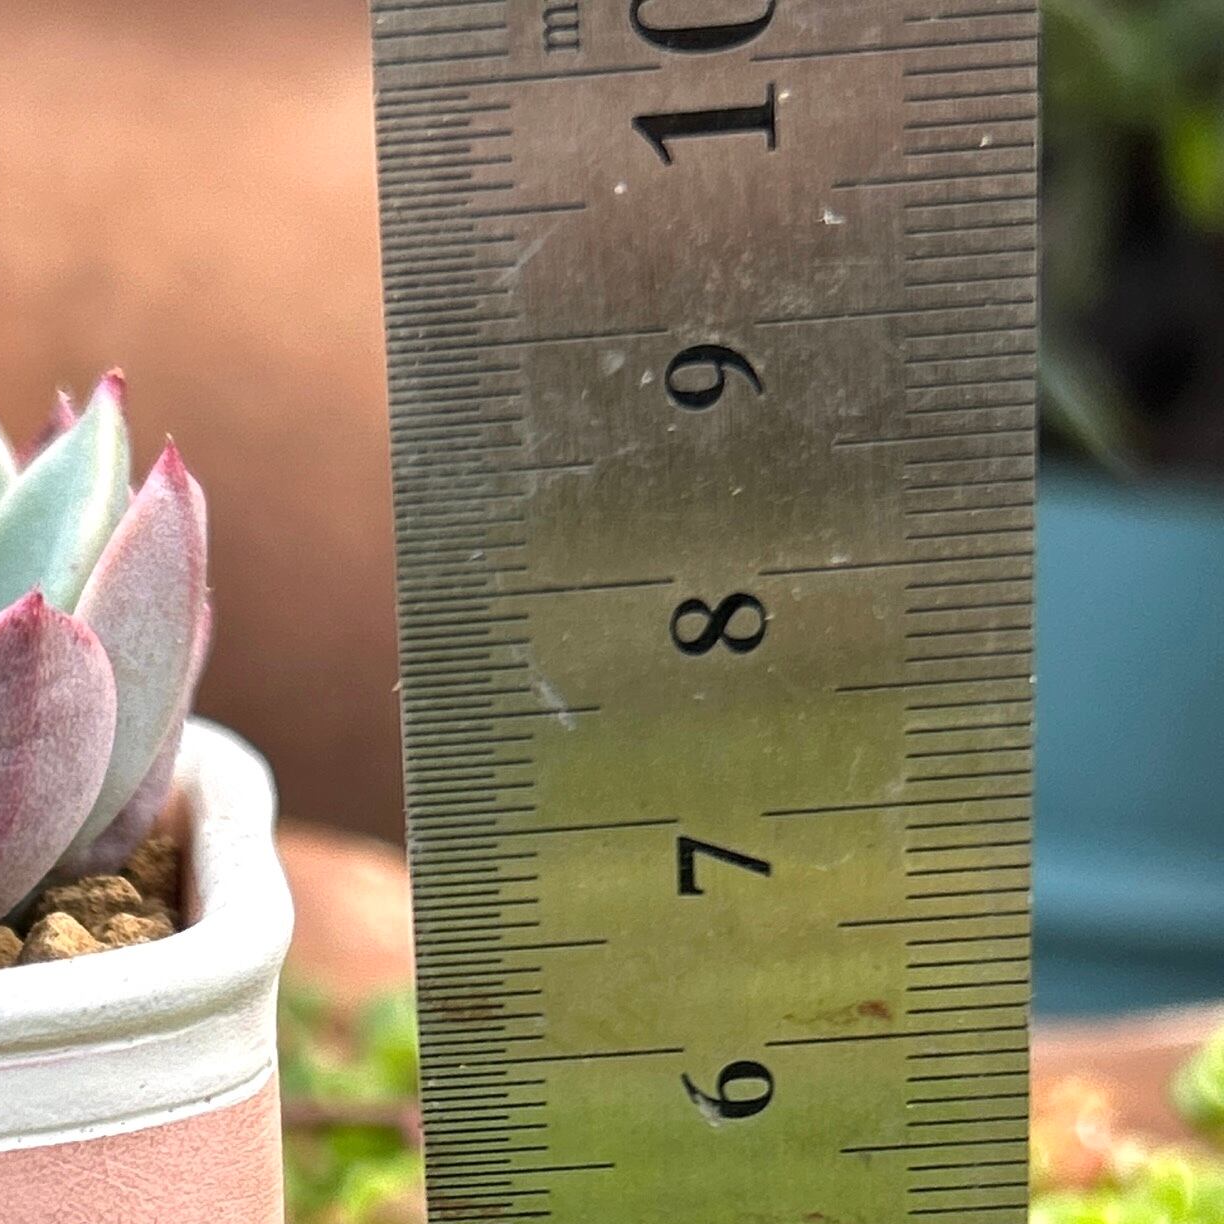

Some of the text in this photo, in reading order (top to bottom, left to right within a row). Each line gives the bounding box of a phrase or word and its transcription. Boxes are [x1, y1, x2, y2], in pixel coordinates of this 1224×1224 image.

[664, 344, 764, 413] 9
[669, 591, 768, 656] 8
[677, 835, 772, 896] 7
[681, 1060, 775, 1120] 6
